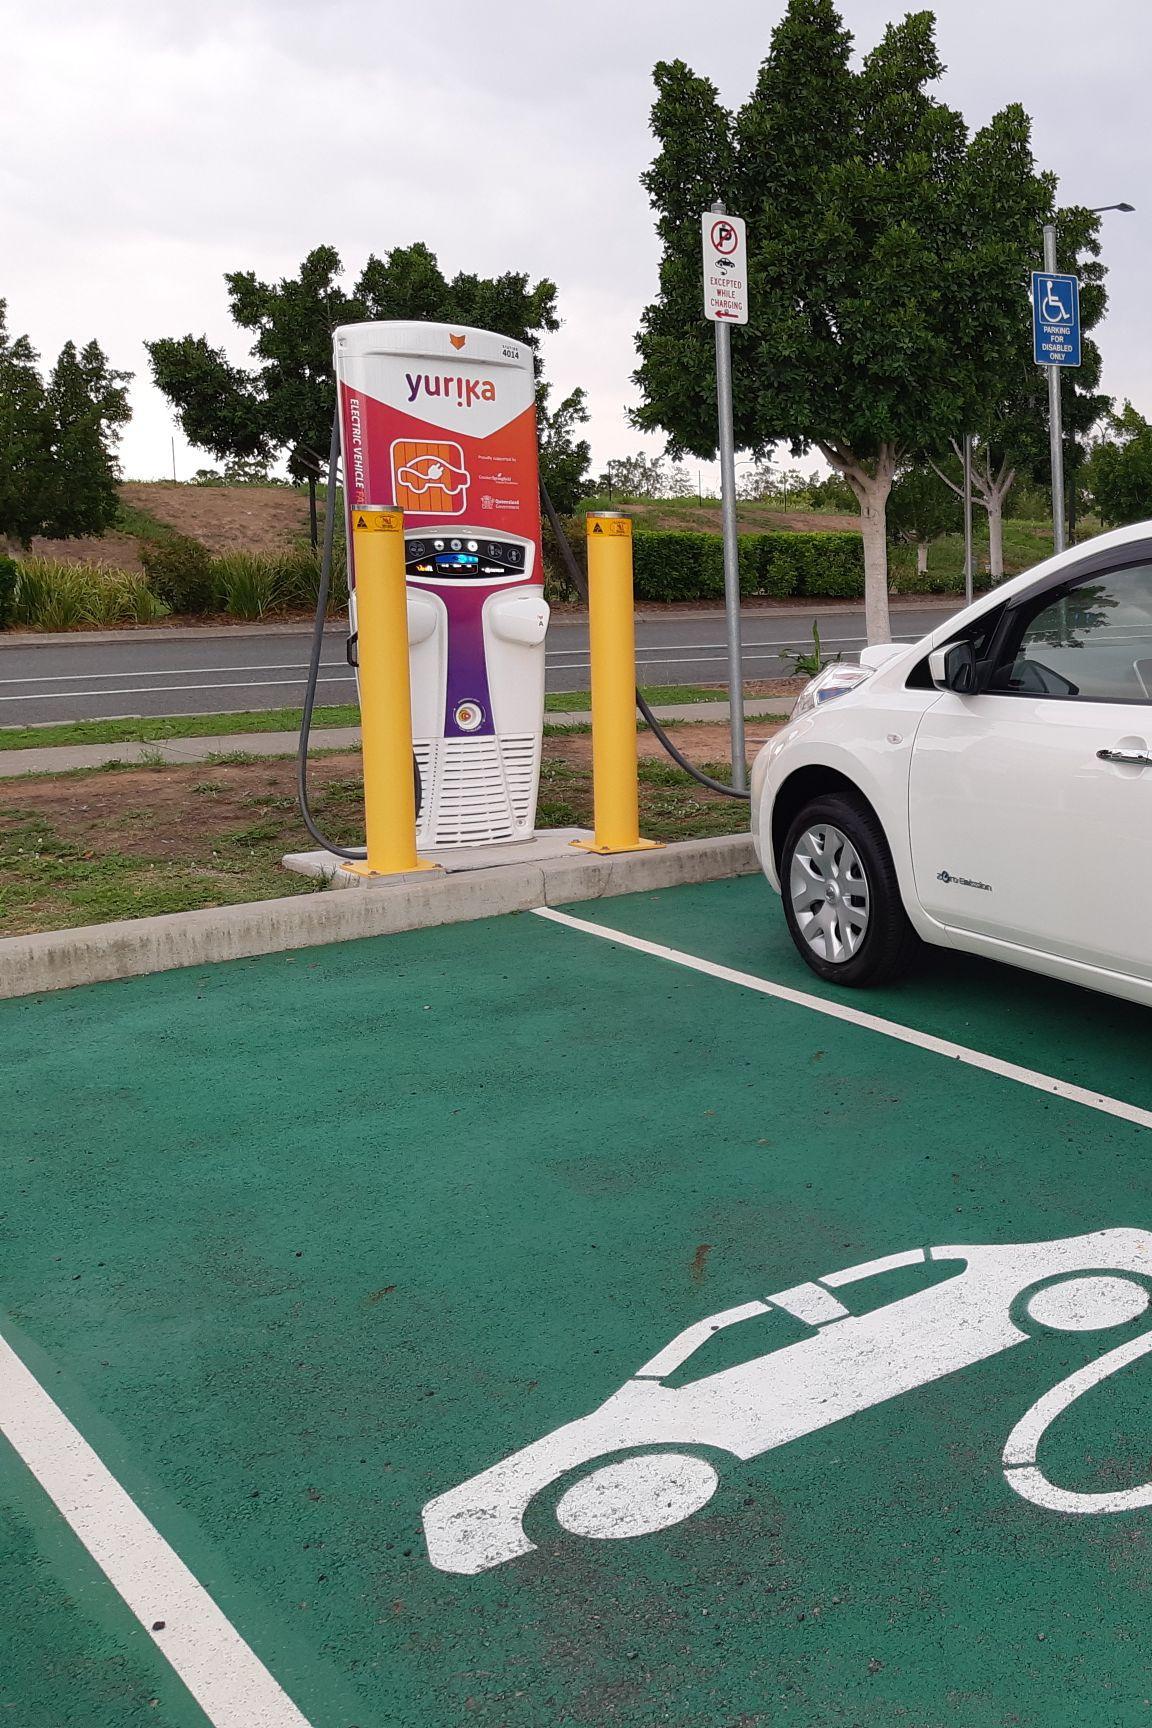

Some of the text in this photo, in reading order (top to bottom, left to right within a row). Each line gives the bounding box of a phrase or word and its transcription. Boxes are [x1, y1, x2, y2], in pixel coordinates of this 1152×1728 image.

[710, 276, 742, 289] EXCEPTED
[716, 288, 736, 299] WHILE
[710, 298, 743, 311] CHARGING
[1043, 326, 1071, 335] PARKING
[1050, 335, 1064, 343] FOR
[1042, 343, 1073, 352] DISABLED
[502, 349, 519, 359] 4014
[1049, 352, 1066, 360] ONLY
[350, 398, 362, 445] ELECTRIC
[353, 447, 365, 489] VEHICLE
